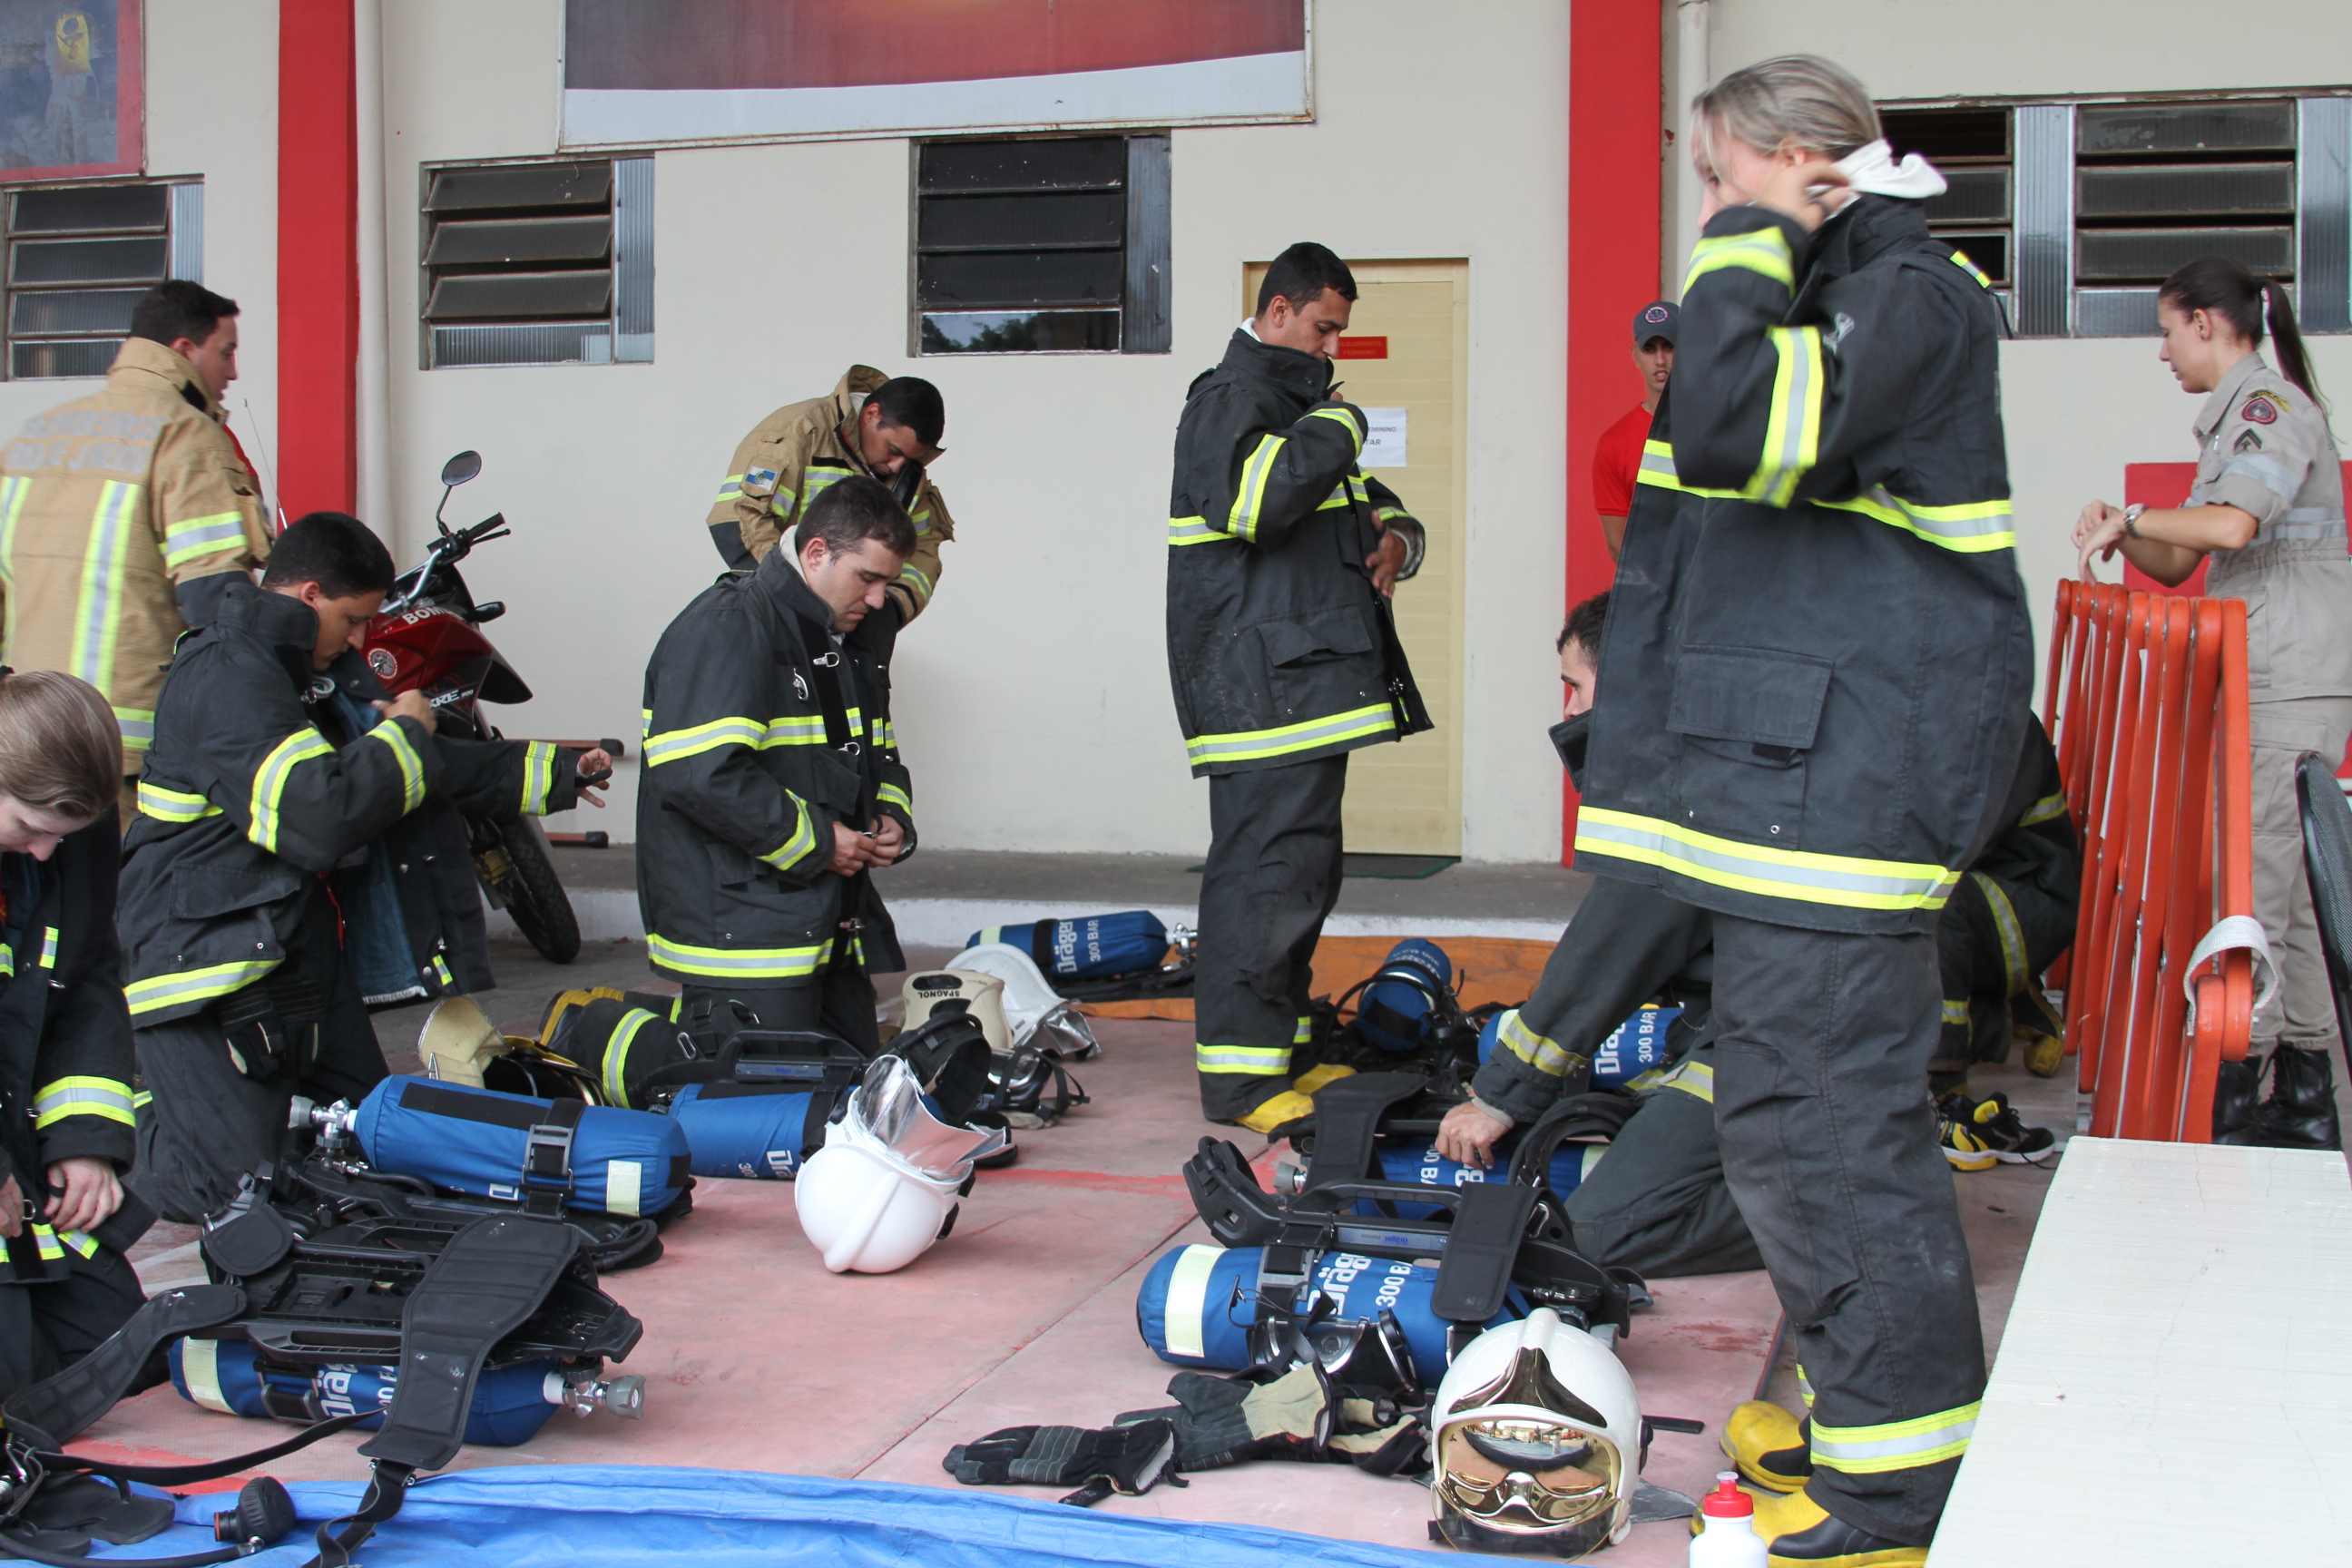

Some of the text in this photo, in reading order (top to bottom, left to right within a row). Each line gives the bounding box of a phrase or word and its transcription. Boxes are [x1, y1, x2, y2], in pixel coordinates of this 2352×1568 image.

[402, 606, 454, 625] BOM
[1054, 920, 1078, 974] Dräger
[1087, 919, 1102, 963] 300 BAR
[917, 990, 961, 999] SPAGNOL
[1637, 1011, 1658, 1063] 300 BAR
[1375, 1276, 1406, 1308] 300
